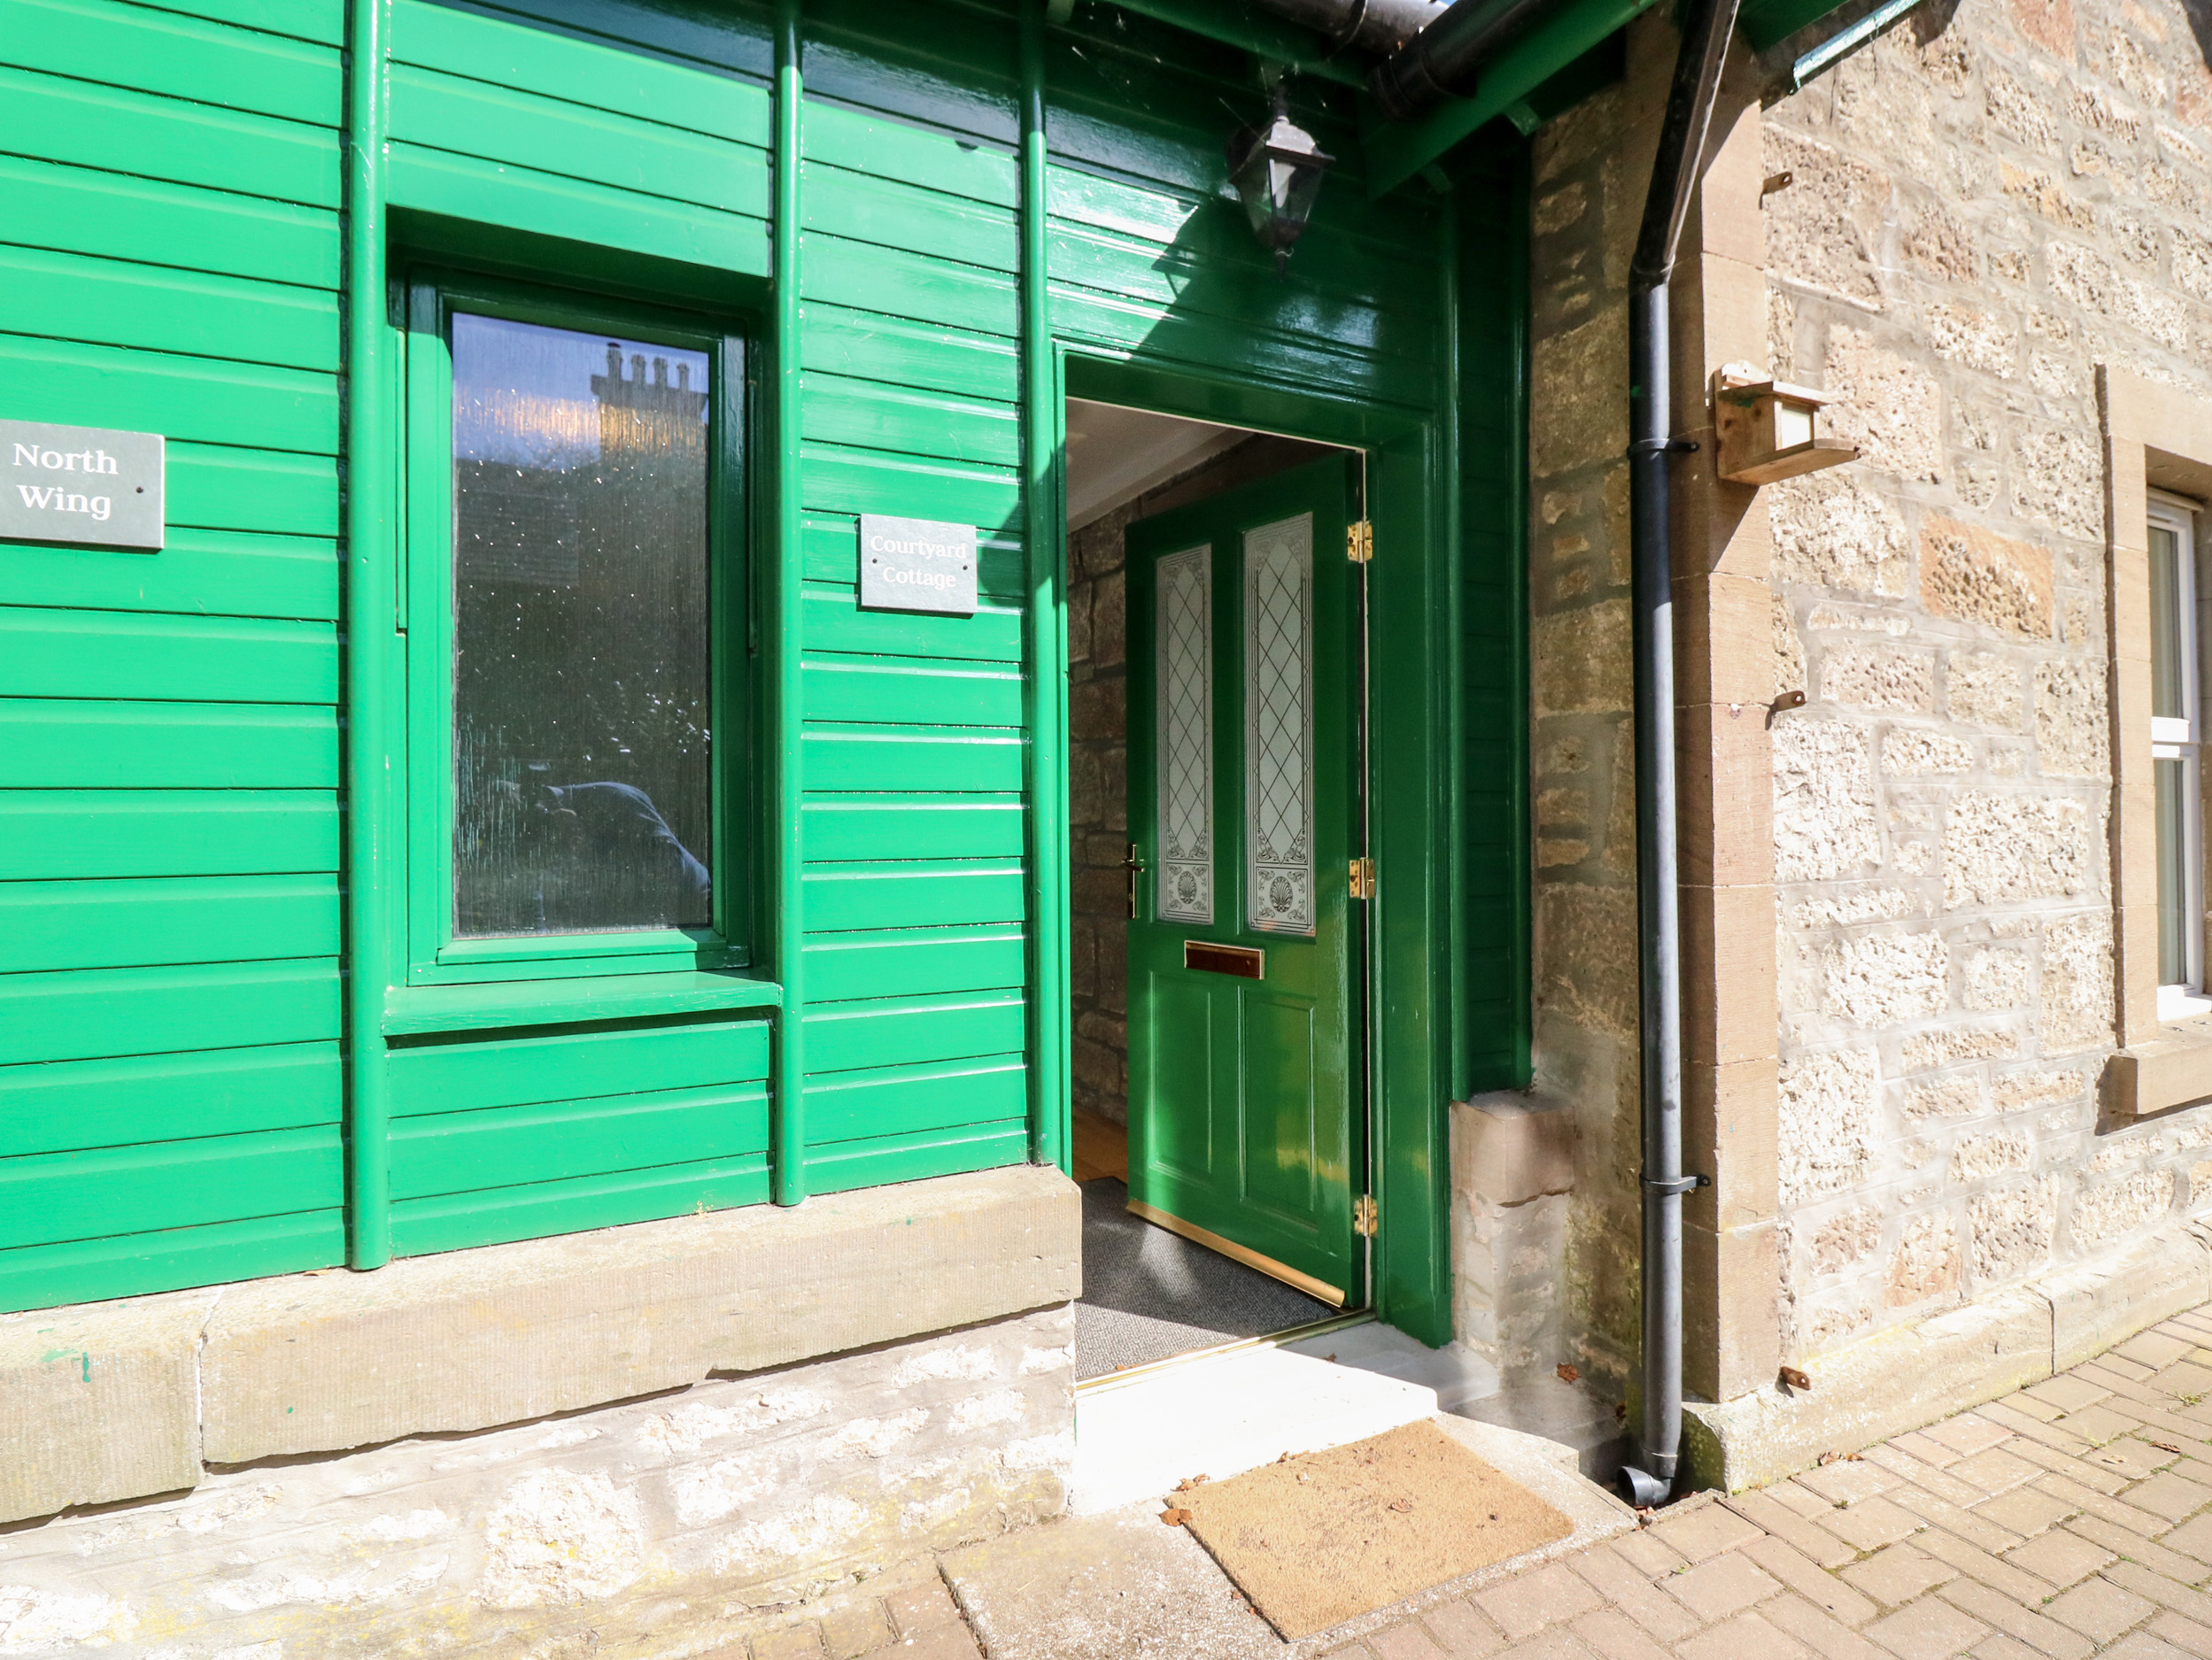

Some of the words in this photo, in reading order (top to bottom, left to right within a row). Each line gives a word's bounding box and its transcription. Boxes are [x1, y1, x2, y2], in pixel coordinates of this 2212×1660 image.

[12, 443, 120, 475] North
[16, 484, 112, 521] Wing
[870, 535, 968, 560] Courtyard
[882, 567, 956, 591] Cottage
